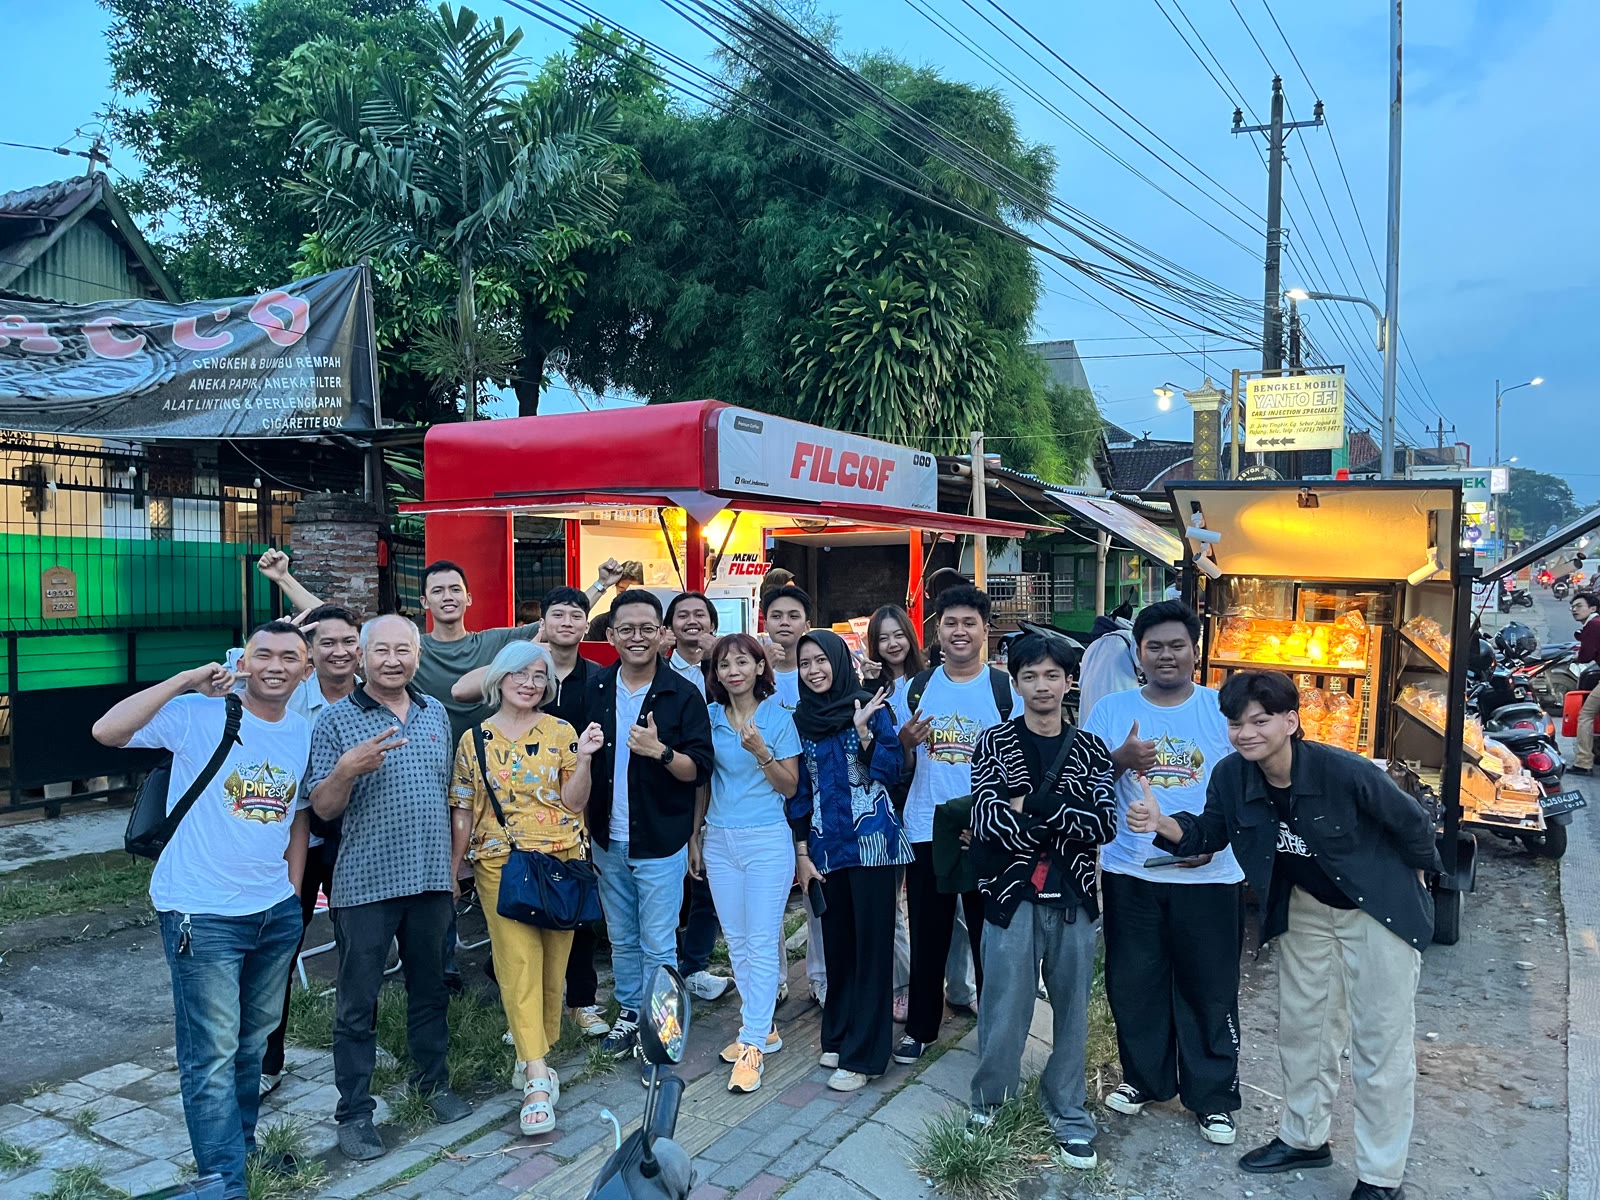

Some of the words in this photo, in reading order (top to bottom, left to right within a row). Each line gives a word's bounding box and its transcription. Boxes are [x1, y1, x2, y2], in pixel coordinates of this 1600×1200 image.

[193, 357, 248, 370] CENGKEH
[250, 358, 257, 370] &
[296, 356, 341, 369] REMPAH
[189, 378, 226, 391] ANEKA
[265, 377, 309, 389] ANEKA
[310, 376, 342, 389] FILTER
[1253, 382, 1302, 393] BENGKEL
[1304, 380, 1338, 390] MOBIL
[162, 399, 194, 411] ALAT
[195, 398, 241, 411] LINTING
[245, 398, 253, 410] &
[256, 397, 342, 410] PERLENGKAPAN
[1253, 392, 1310, 409] YANTO
[1313, 390, 1338, 407] EFI
[1302, 407, 1338, 415] SPECIALIST
[262, 416, 320, 430] CIGARETTE
[323, 416, 342, 428] BOX
[790, 441, 896, 492] FILCOF
[732, 553, 758, 562] MENU
[728, 562, 771, 576] FILCOF
[933, 729, 975, 743] PNFest
[1153, 752, 1189, 766] NFest
[241, 779, 286, 798] PNFest
